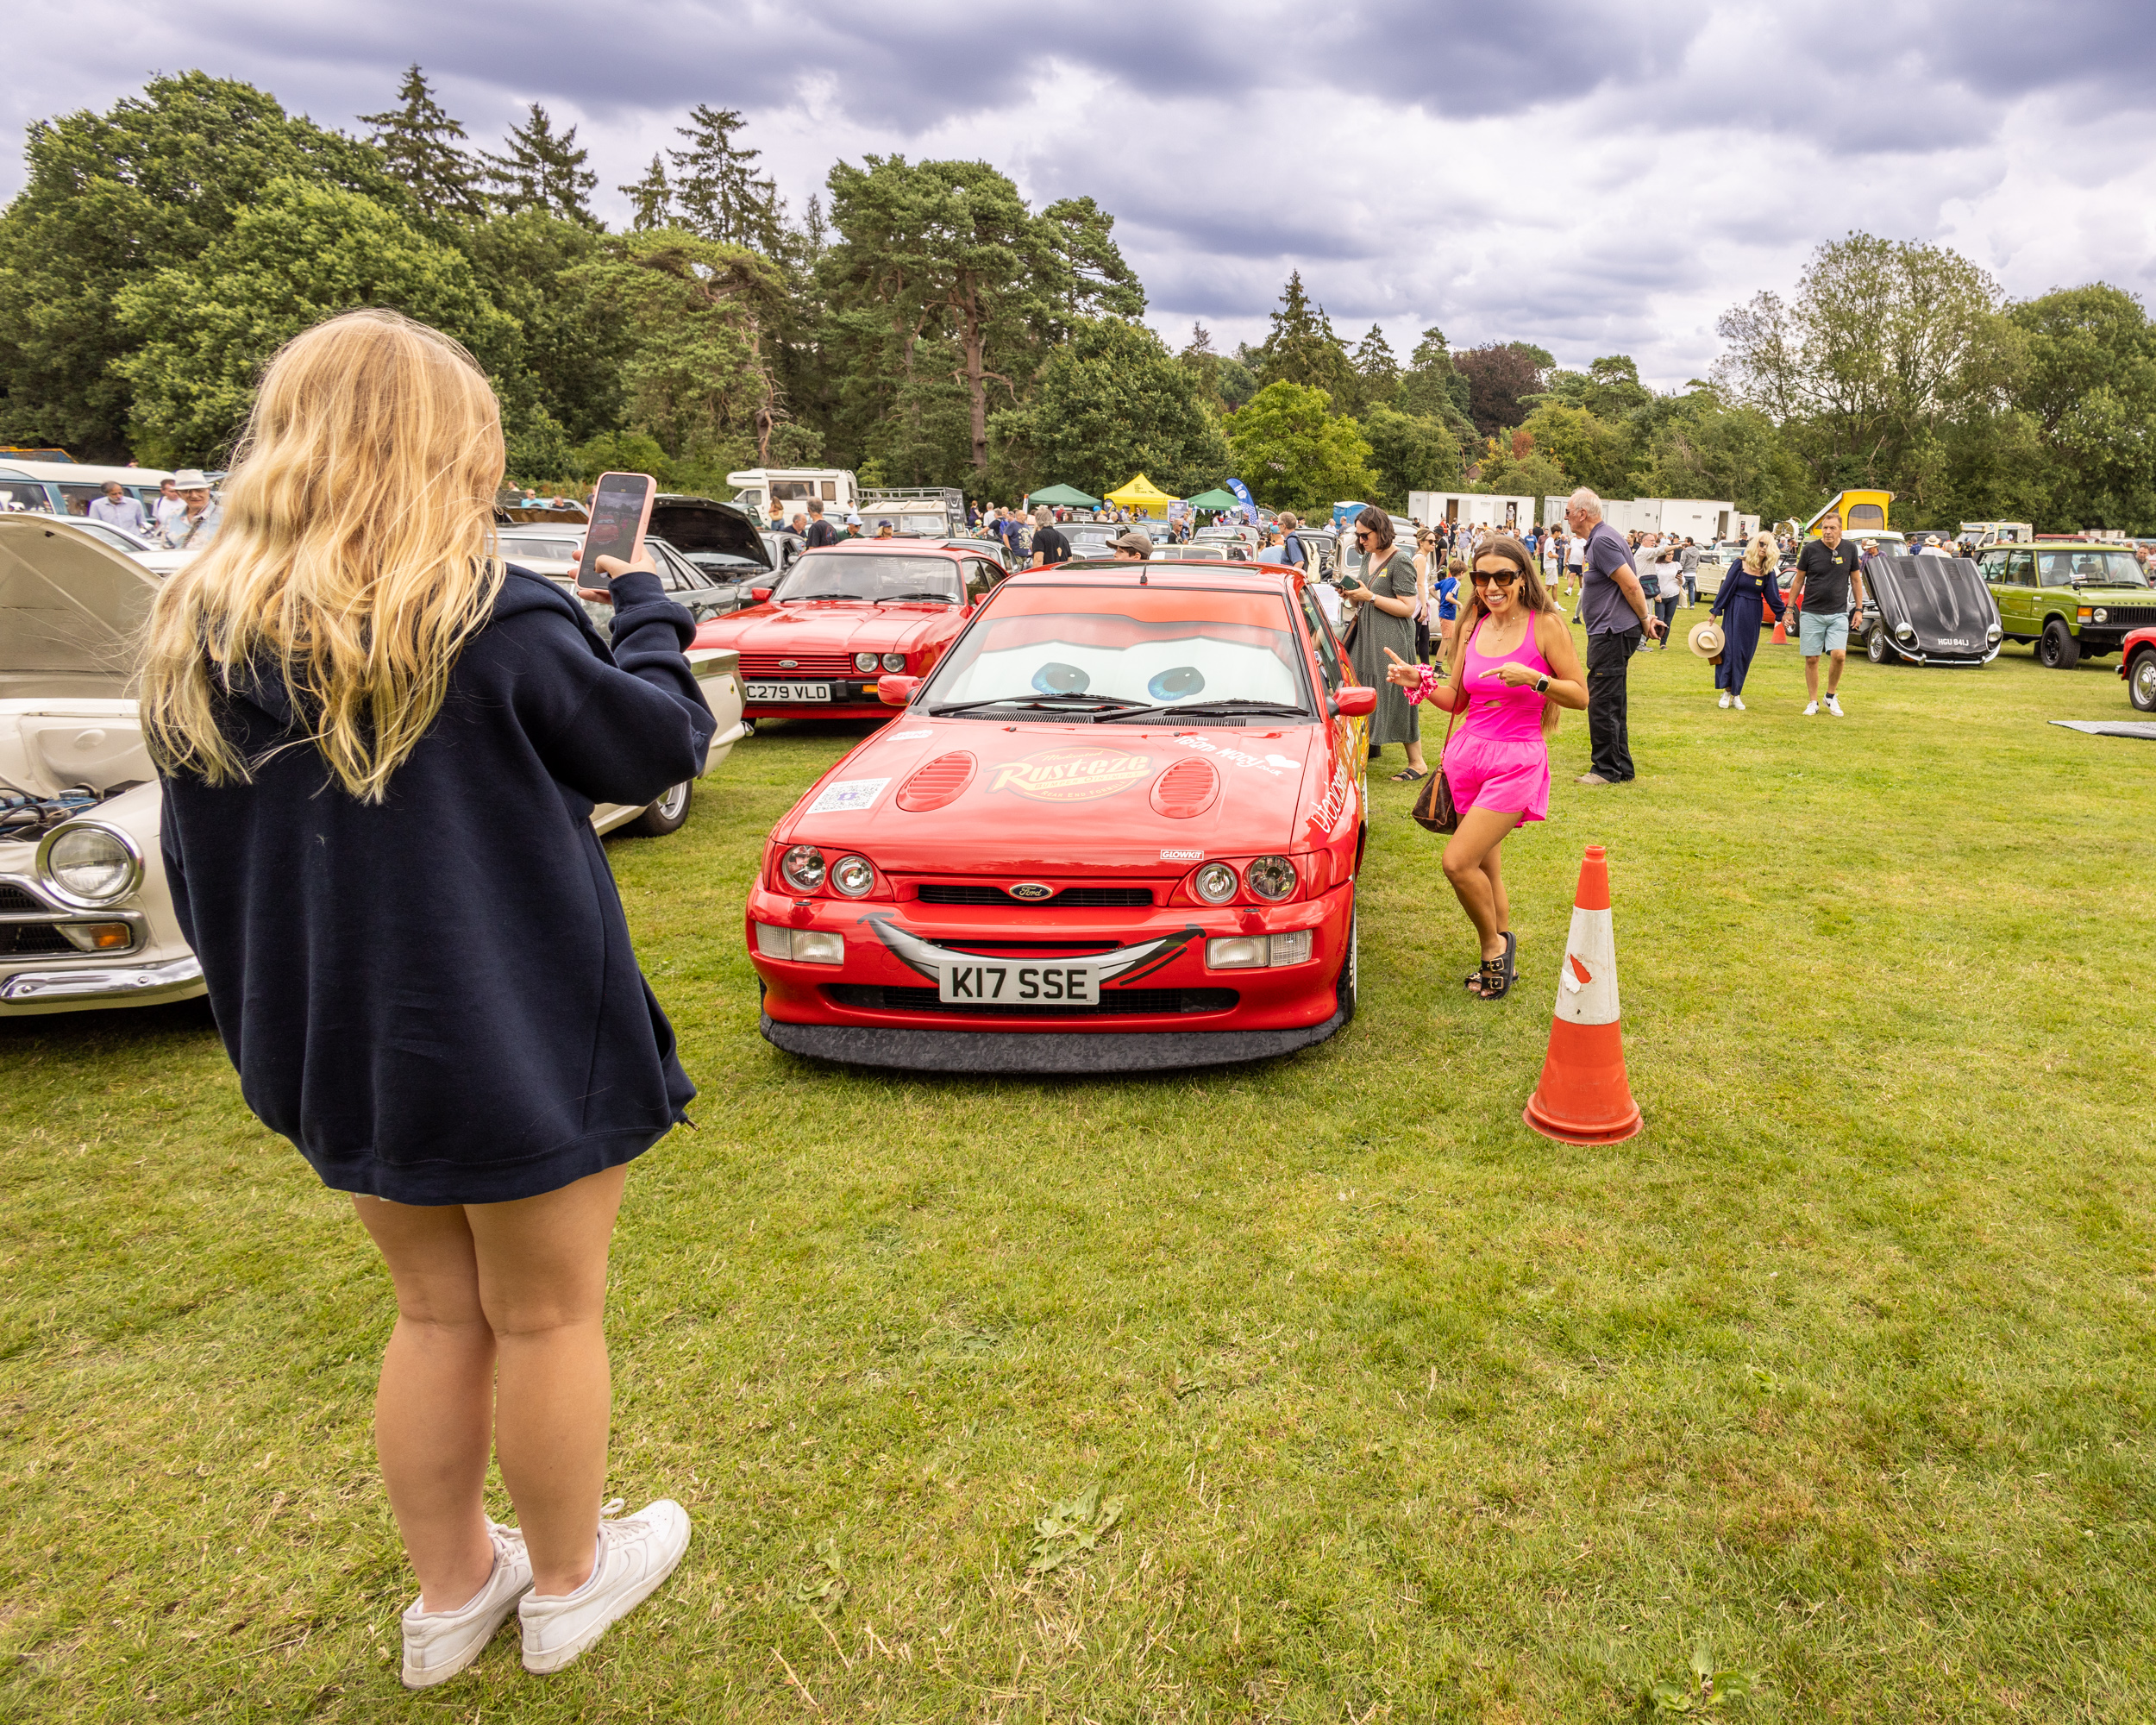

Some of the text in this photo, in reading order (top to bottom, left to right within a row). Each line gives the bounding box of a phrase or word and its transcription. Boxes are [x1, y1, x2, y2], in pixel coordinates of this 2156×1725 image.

[747, 686, 827, 699] C279 VLD
[1042, 751, 1104, 762] Medicated
[1034, 772, 1139, 789] BUMPER OINTMENT
[1090, 781, 1127, 794] FORMULA
[1018, 886, 1043, 897] Ford
[952, 967, 1087, 999] K17 SSE
